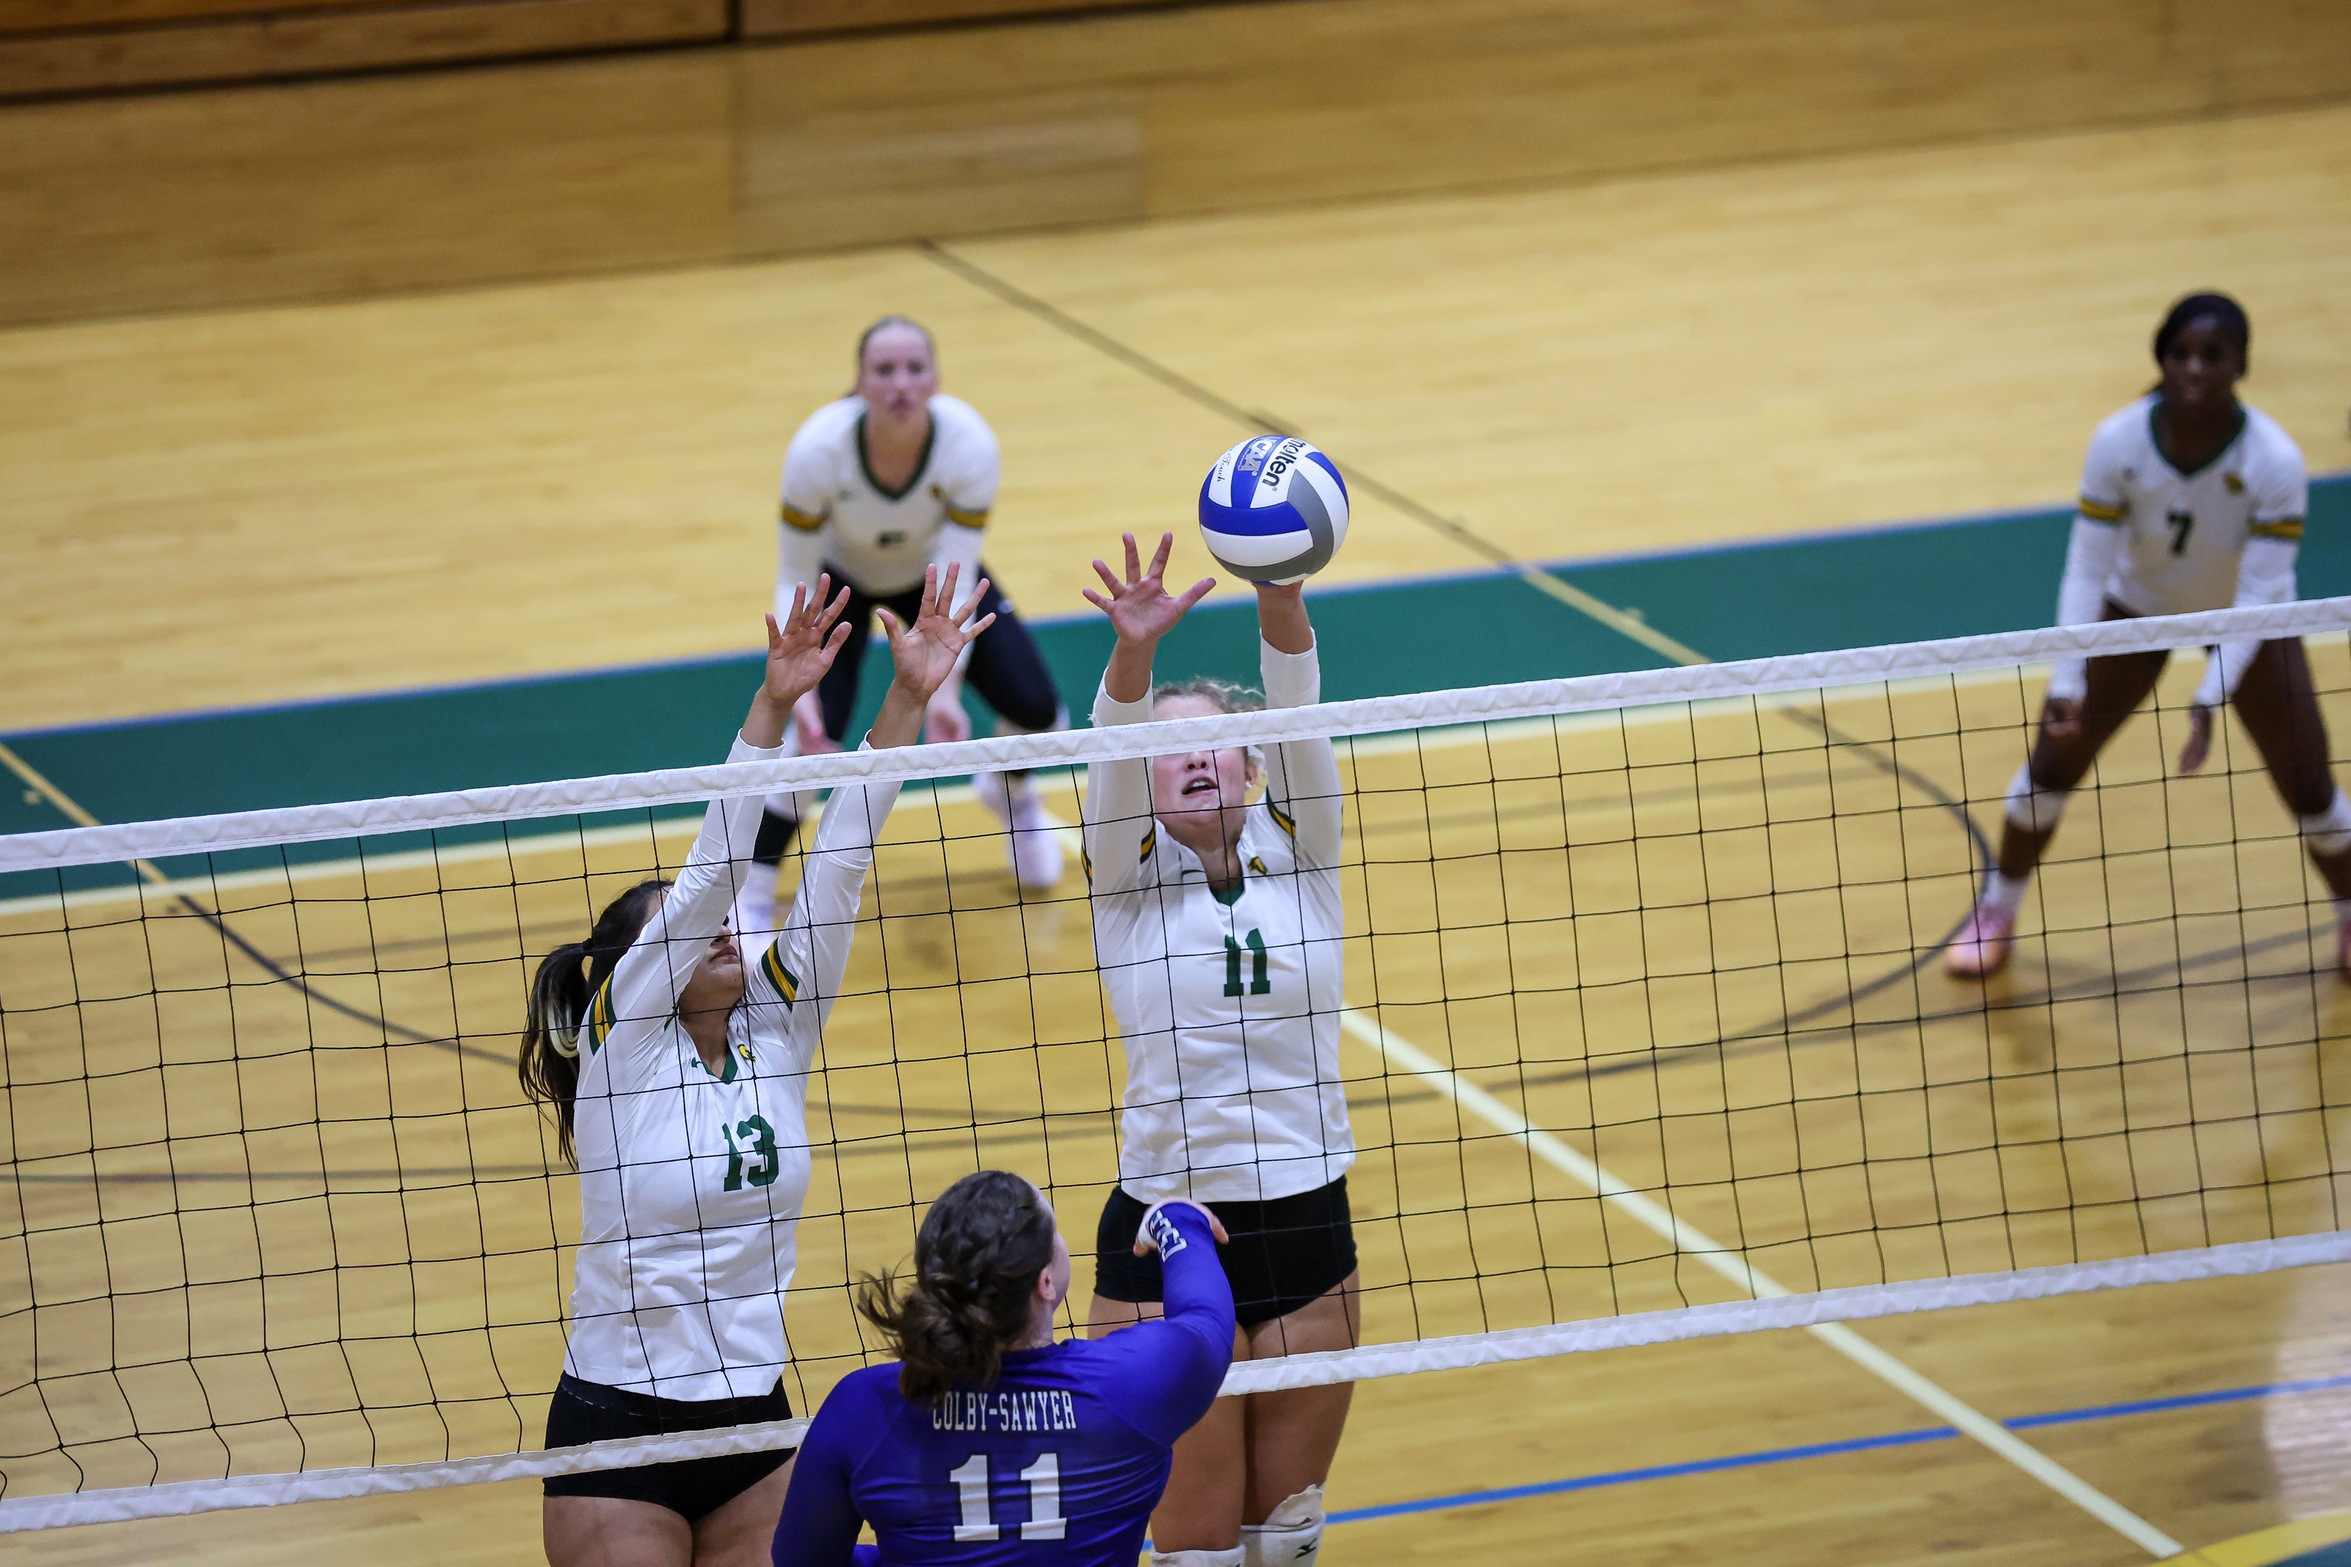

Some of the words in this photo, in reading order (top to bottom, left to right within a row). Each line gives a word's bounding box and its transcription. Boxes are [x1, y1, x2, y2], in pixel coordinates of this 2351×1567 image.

[1262, 439, 1306, 487] molten
[2165, 509, 2194, 557] 7
[1223, 928, 1271, 998] 11
[721, 1114, 780, 1192] 13
[932, 1390, 1077, 1432] COLBY-SAWYER
[950, 1453, 1067, 1541] 11
